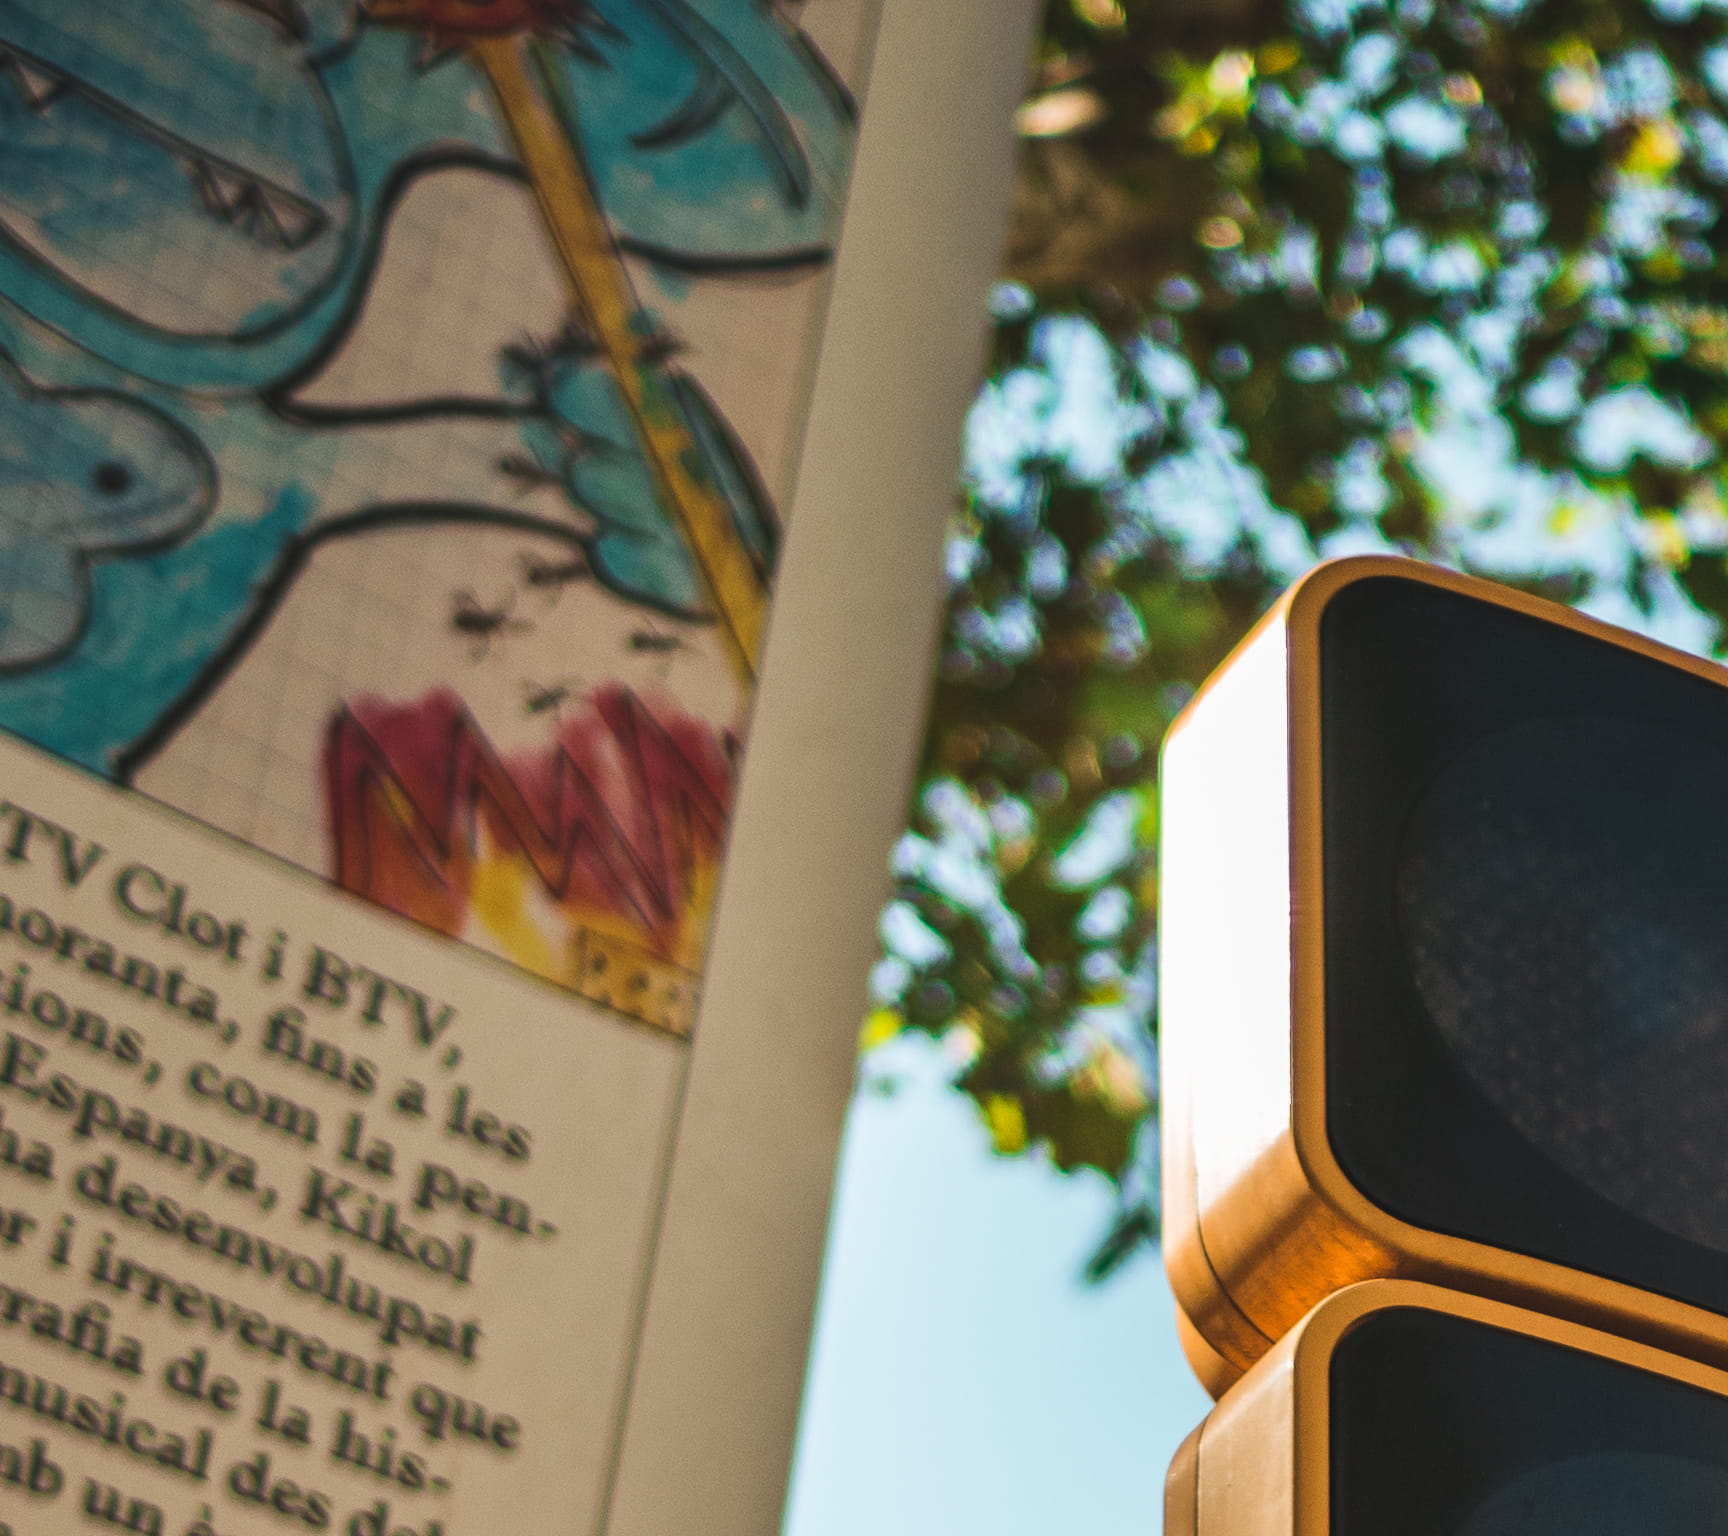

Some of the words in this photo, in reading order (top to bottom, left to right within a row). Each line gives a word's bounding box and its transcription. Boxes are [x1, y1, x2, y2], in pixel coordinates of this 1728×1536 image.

[112, 862, 249, 965] Clot
[261, 930, 289, 984] i
[303, 944, 463, 1071] BTV,
[0, 1031, 279, 1212] Espanya,
[299, 1168, 475, 1290] Kikol
[185, 1061, 319, 1147] com
[340, 1112, 395, 1178] la
[262, 1008, 376, 1098] fins
[392, 1078, 427, 1121] a
[443, 1084, 533, 1166] les
[0, 1207, 37, 1252] r
[48, 1214, 74, 1271] i
[89, 1232, 395, 1403] irreverent
[411, 1381, 522, 1456] que
[73, 1156, 484, 1368] desenvolupat
[0, 1284, 145, 1380] rafia
[164, 1346, 241, 1414] de
[256, 1378, 312, 1449] la
[330, 1408, 452, 1498] his-
[227, 1451, 331, 1533] des
